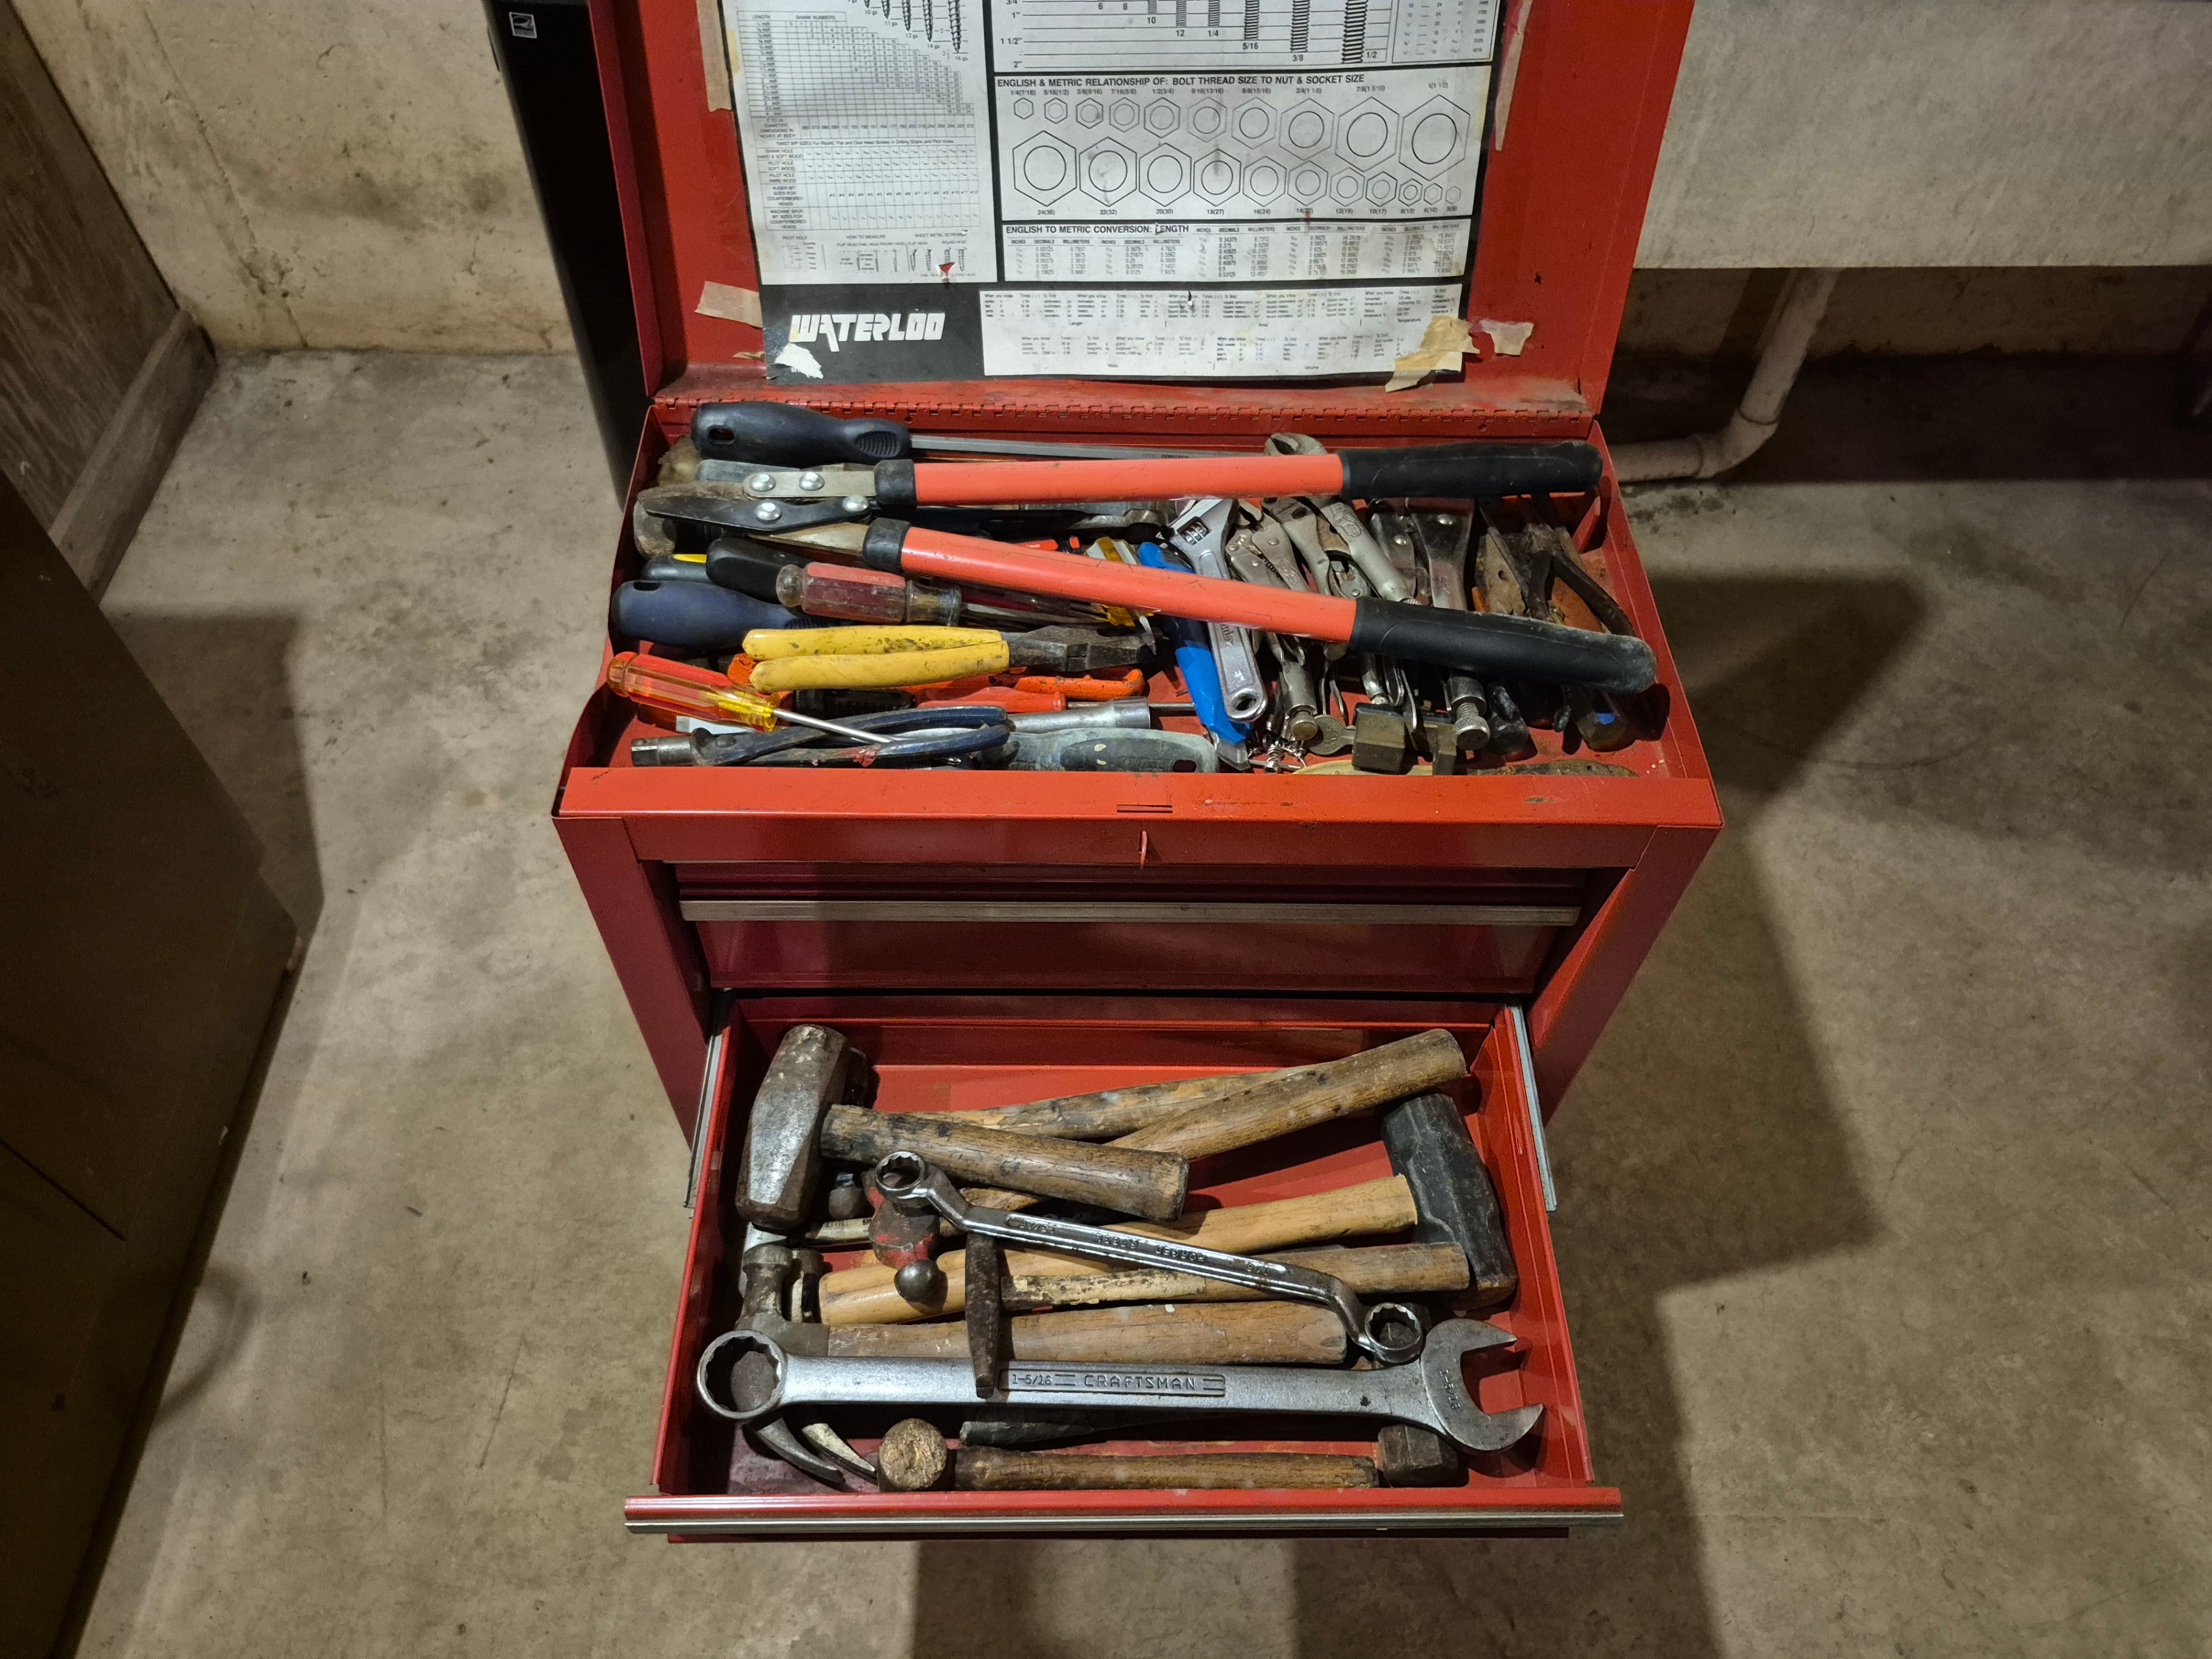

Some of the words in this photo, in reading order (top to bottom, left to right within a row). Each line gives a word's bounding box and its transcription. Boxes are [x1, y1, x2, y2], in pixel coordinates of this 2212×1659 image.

[1086, 77, 1150, 86] RELATIONSHIP
[1153, 77, 1168, 86] OF:
[1172, 77, 1195, 86] BOLT
[1198, 76, 1235, 84] THREAD
[1306, 76, 1343, 84] SOCKET
[1345, 75, 1364, 83] SIZE
[1094, 225, 1152, 233] CONVERSION:
[1155, 225, 1189, 233] LENGTH
[789, 313, 945, 352] WATERLOO
[1012, 1374, 1052, 1386] 1-5/16
[1084, 1374, 1196, 1391] CRAFTSMAN
[1439, 1369, 1461, 1410] 1-5/16
